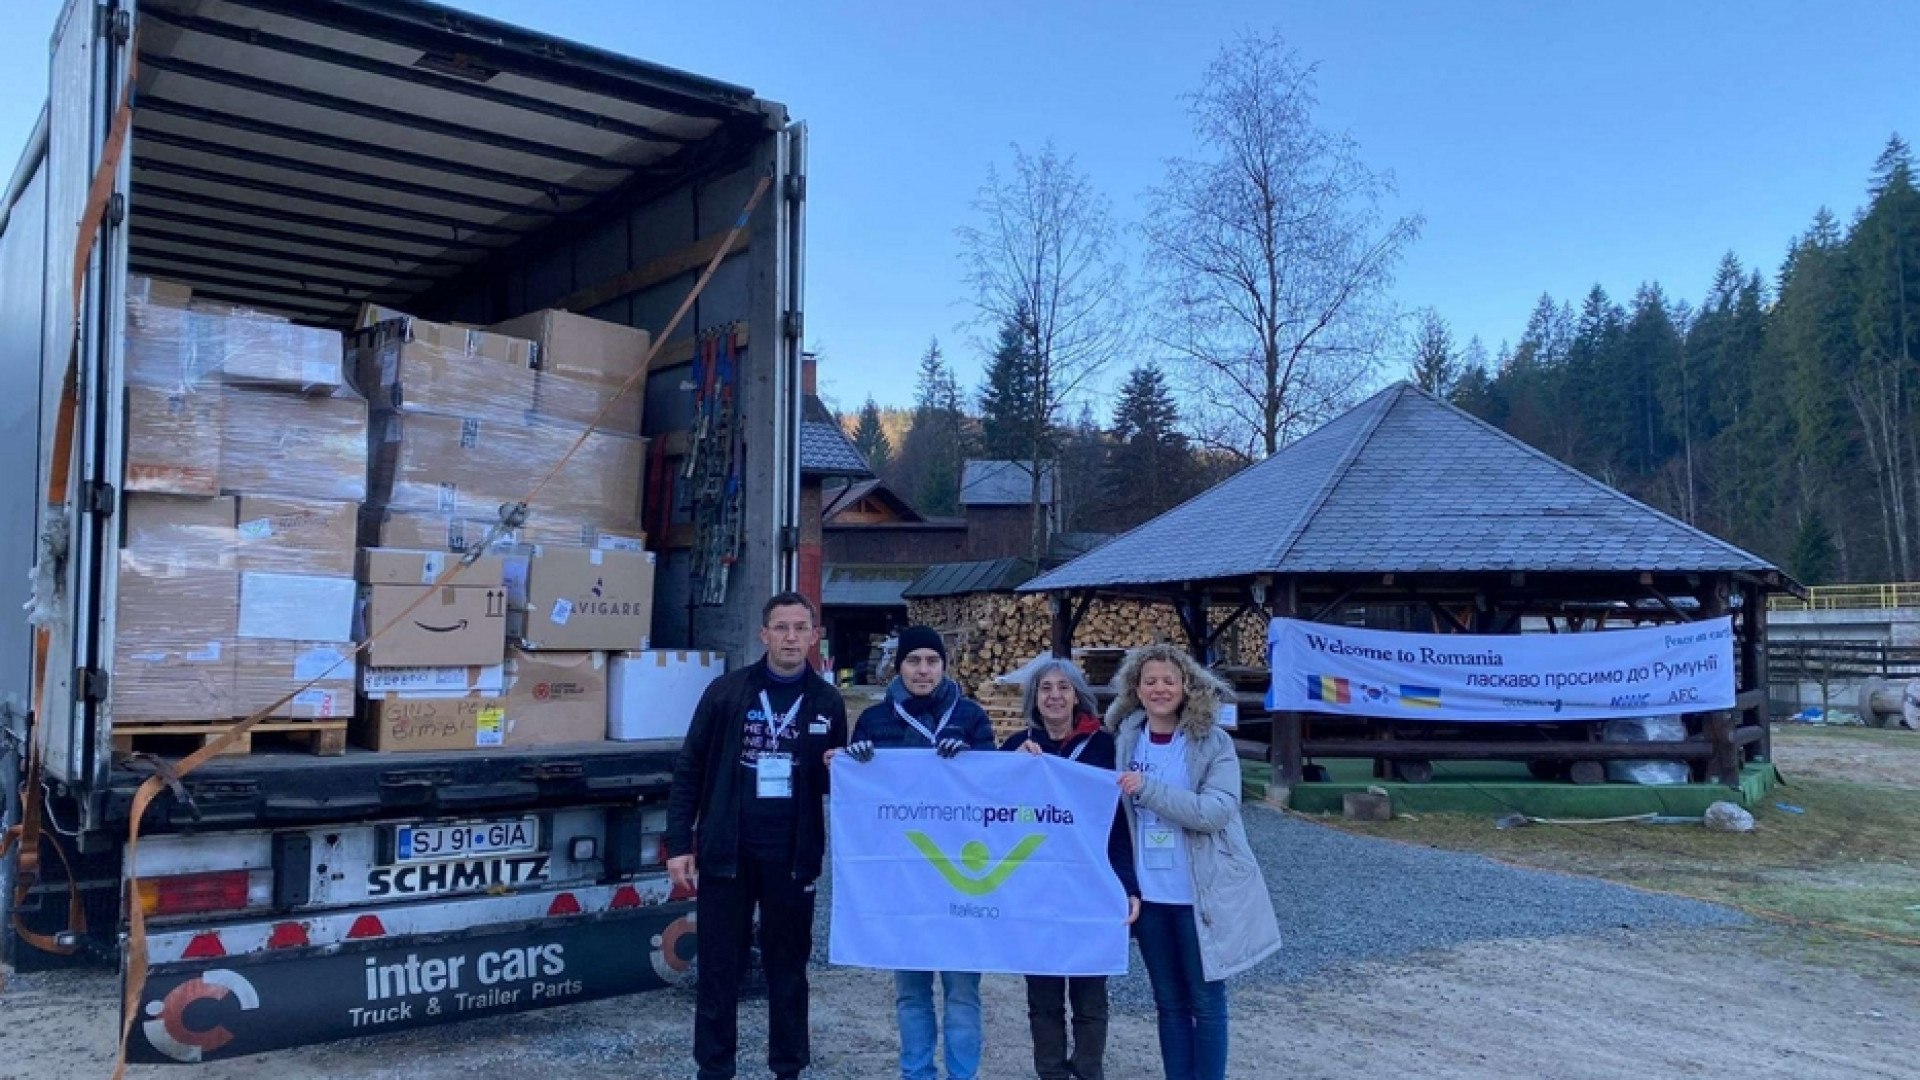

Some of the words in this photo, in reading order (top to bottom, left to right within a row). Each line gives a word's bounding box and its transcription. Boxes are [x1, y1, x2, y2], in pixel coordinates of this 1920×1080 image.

[1305, 633, 1393, 661] Welcome
[1397, 647, 1415, 663] to
[1420, 647, 1504, 666] Romania
[1466, 673, 1540, 688] ласкаво
[1545, 670, 1623, 689] просимо
[1626, 666, 1650, 684] до
[1653, 654, 1719, 681] Румунії
[414, 832, 443, 853] SJ
[451, 827, 472, 850] 91
[488, 823, 527, 847] GIA
[368, 857, 550, 895] SCHMITZ
[949, 902, 1000, 919] Italiano
[365, 952, 466, 1000] inter
[477, 942, 566, 985] cars
[348, 1001, 412, 1027] Truck
[426, 996, 443, 1016] &
[454, 987, 522, 1011] Trailer
[531, 977, 583, 1000] Parts
